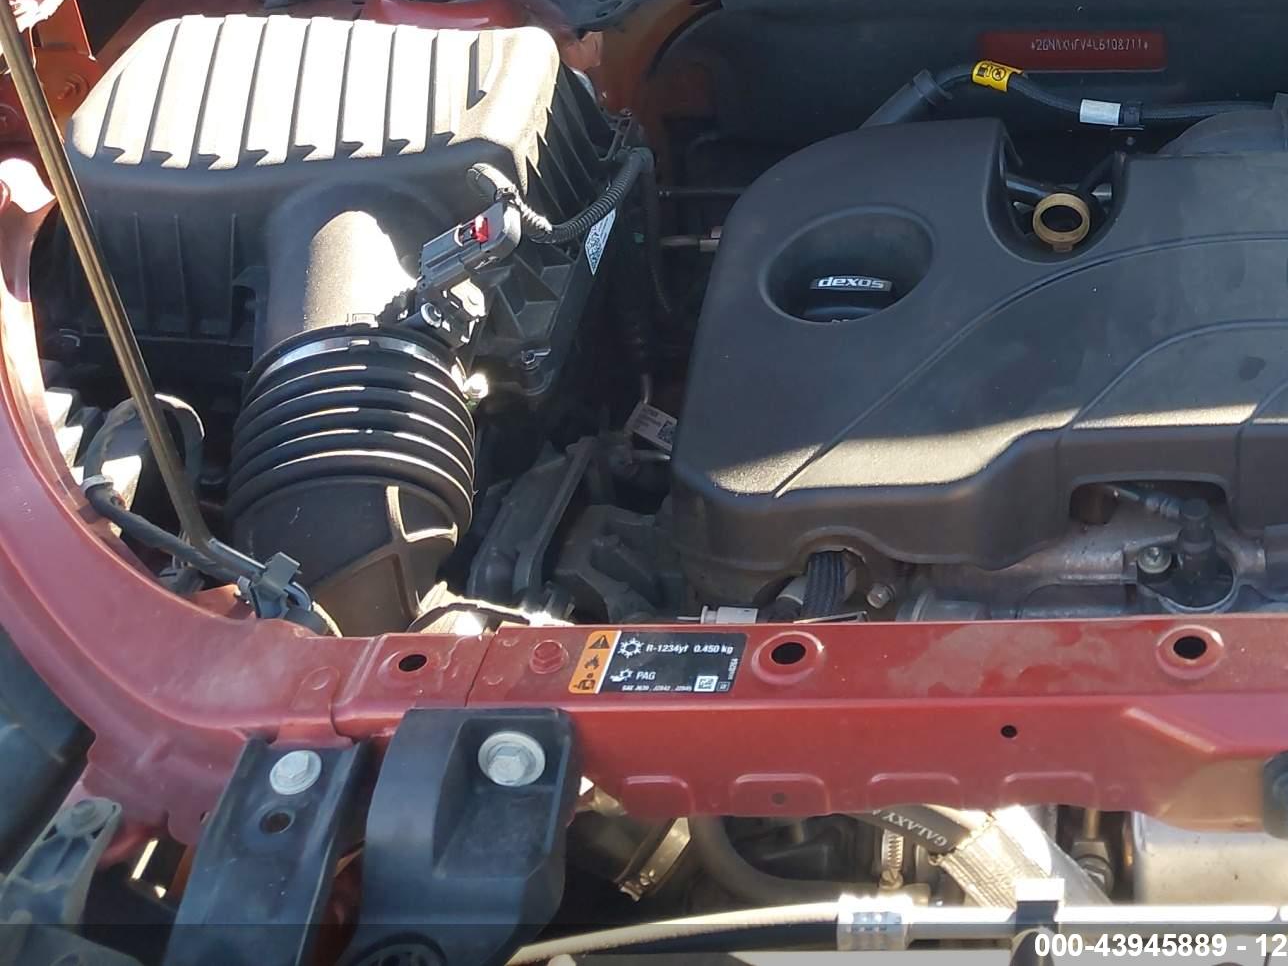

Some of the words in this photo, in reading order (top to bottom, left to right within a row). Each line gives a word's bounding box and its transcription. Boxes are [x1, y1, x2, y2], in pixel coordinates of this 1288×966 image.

[818, 276, 884, 289] dexos
[646, 644, 689, 654] R-1234yf
[693, 644, 720, 653] 0.450
[721, 644, 734, 655] kg
[636, 672, 656, 681] PAG
[883, 812, 948, 846] GALAXY
